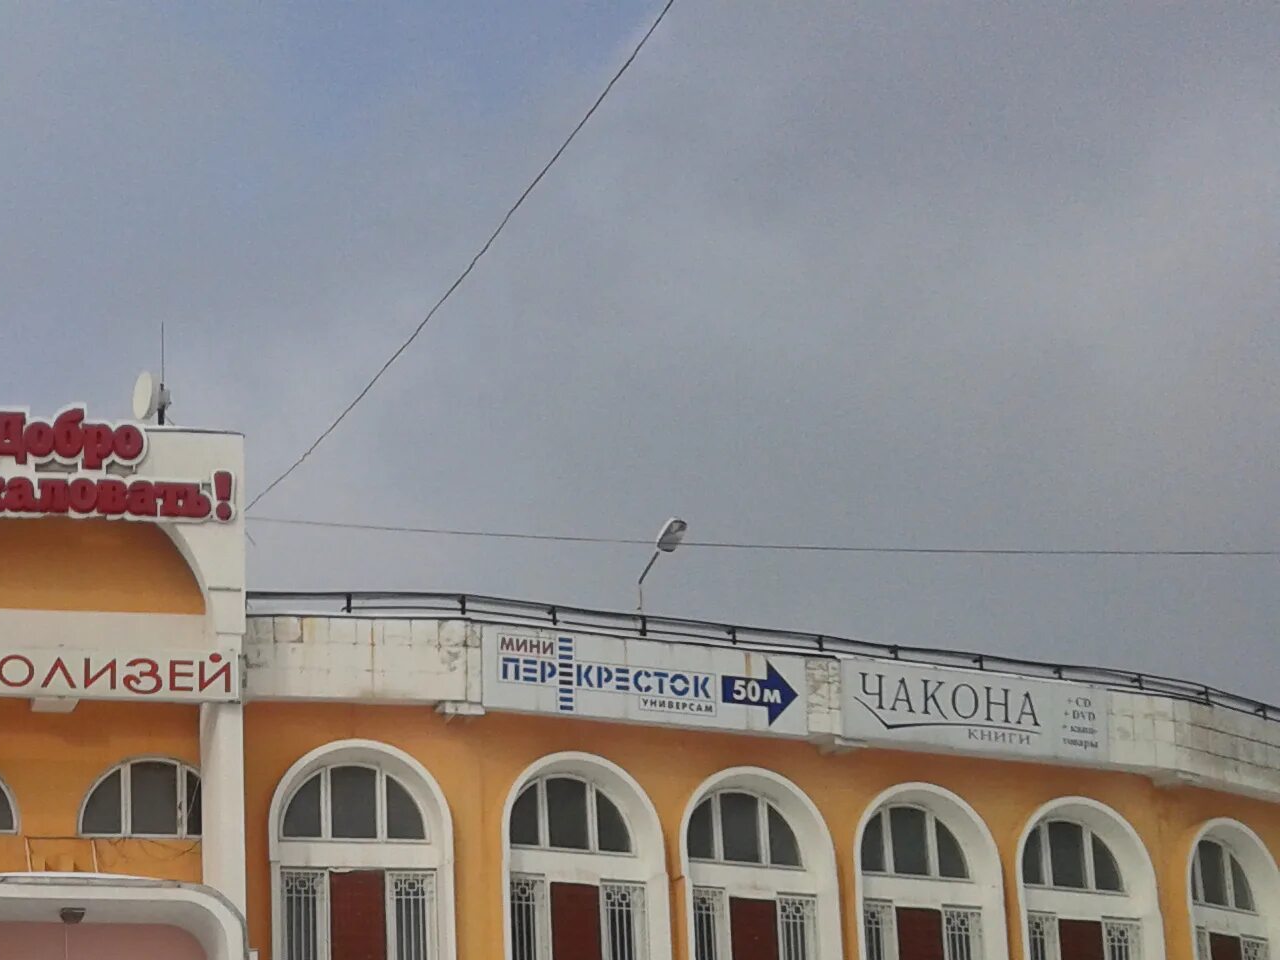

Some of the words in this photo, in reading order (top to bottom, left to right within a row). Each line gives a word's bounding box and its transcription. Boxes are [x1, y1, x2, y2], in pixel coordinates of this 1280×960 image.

[500, 636, 554, 656] МИНИ
[501, 656, 712, 700] ПЕРЕКРЕСТОК
[642, 699, 713, 714] УНИВЕРСАМ
[858, 671, 1042, 727] ЧАКОНА
[967, 728, 1031, 746] КНИГИ
